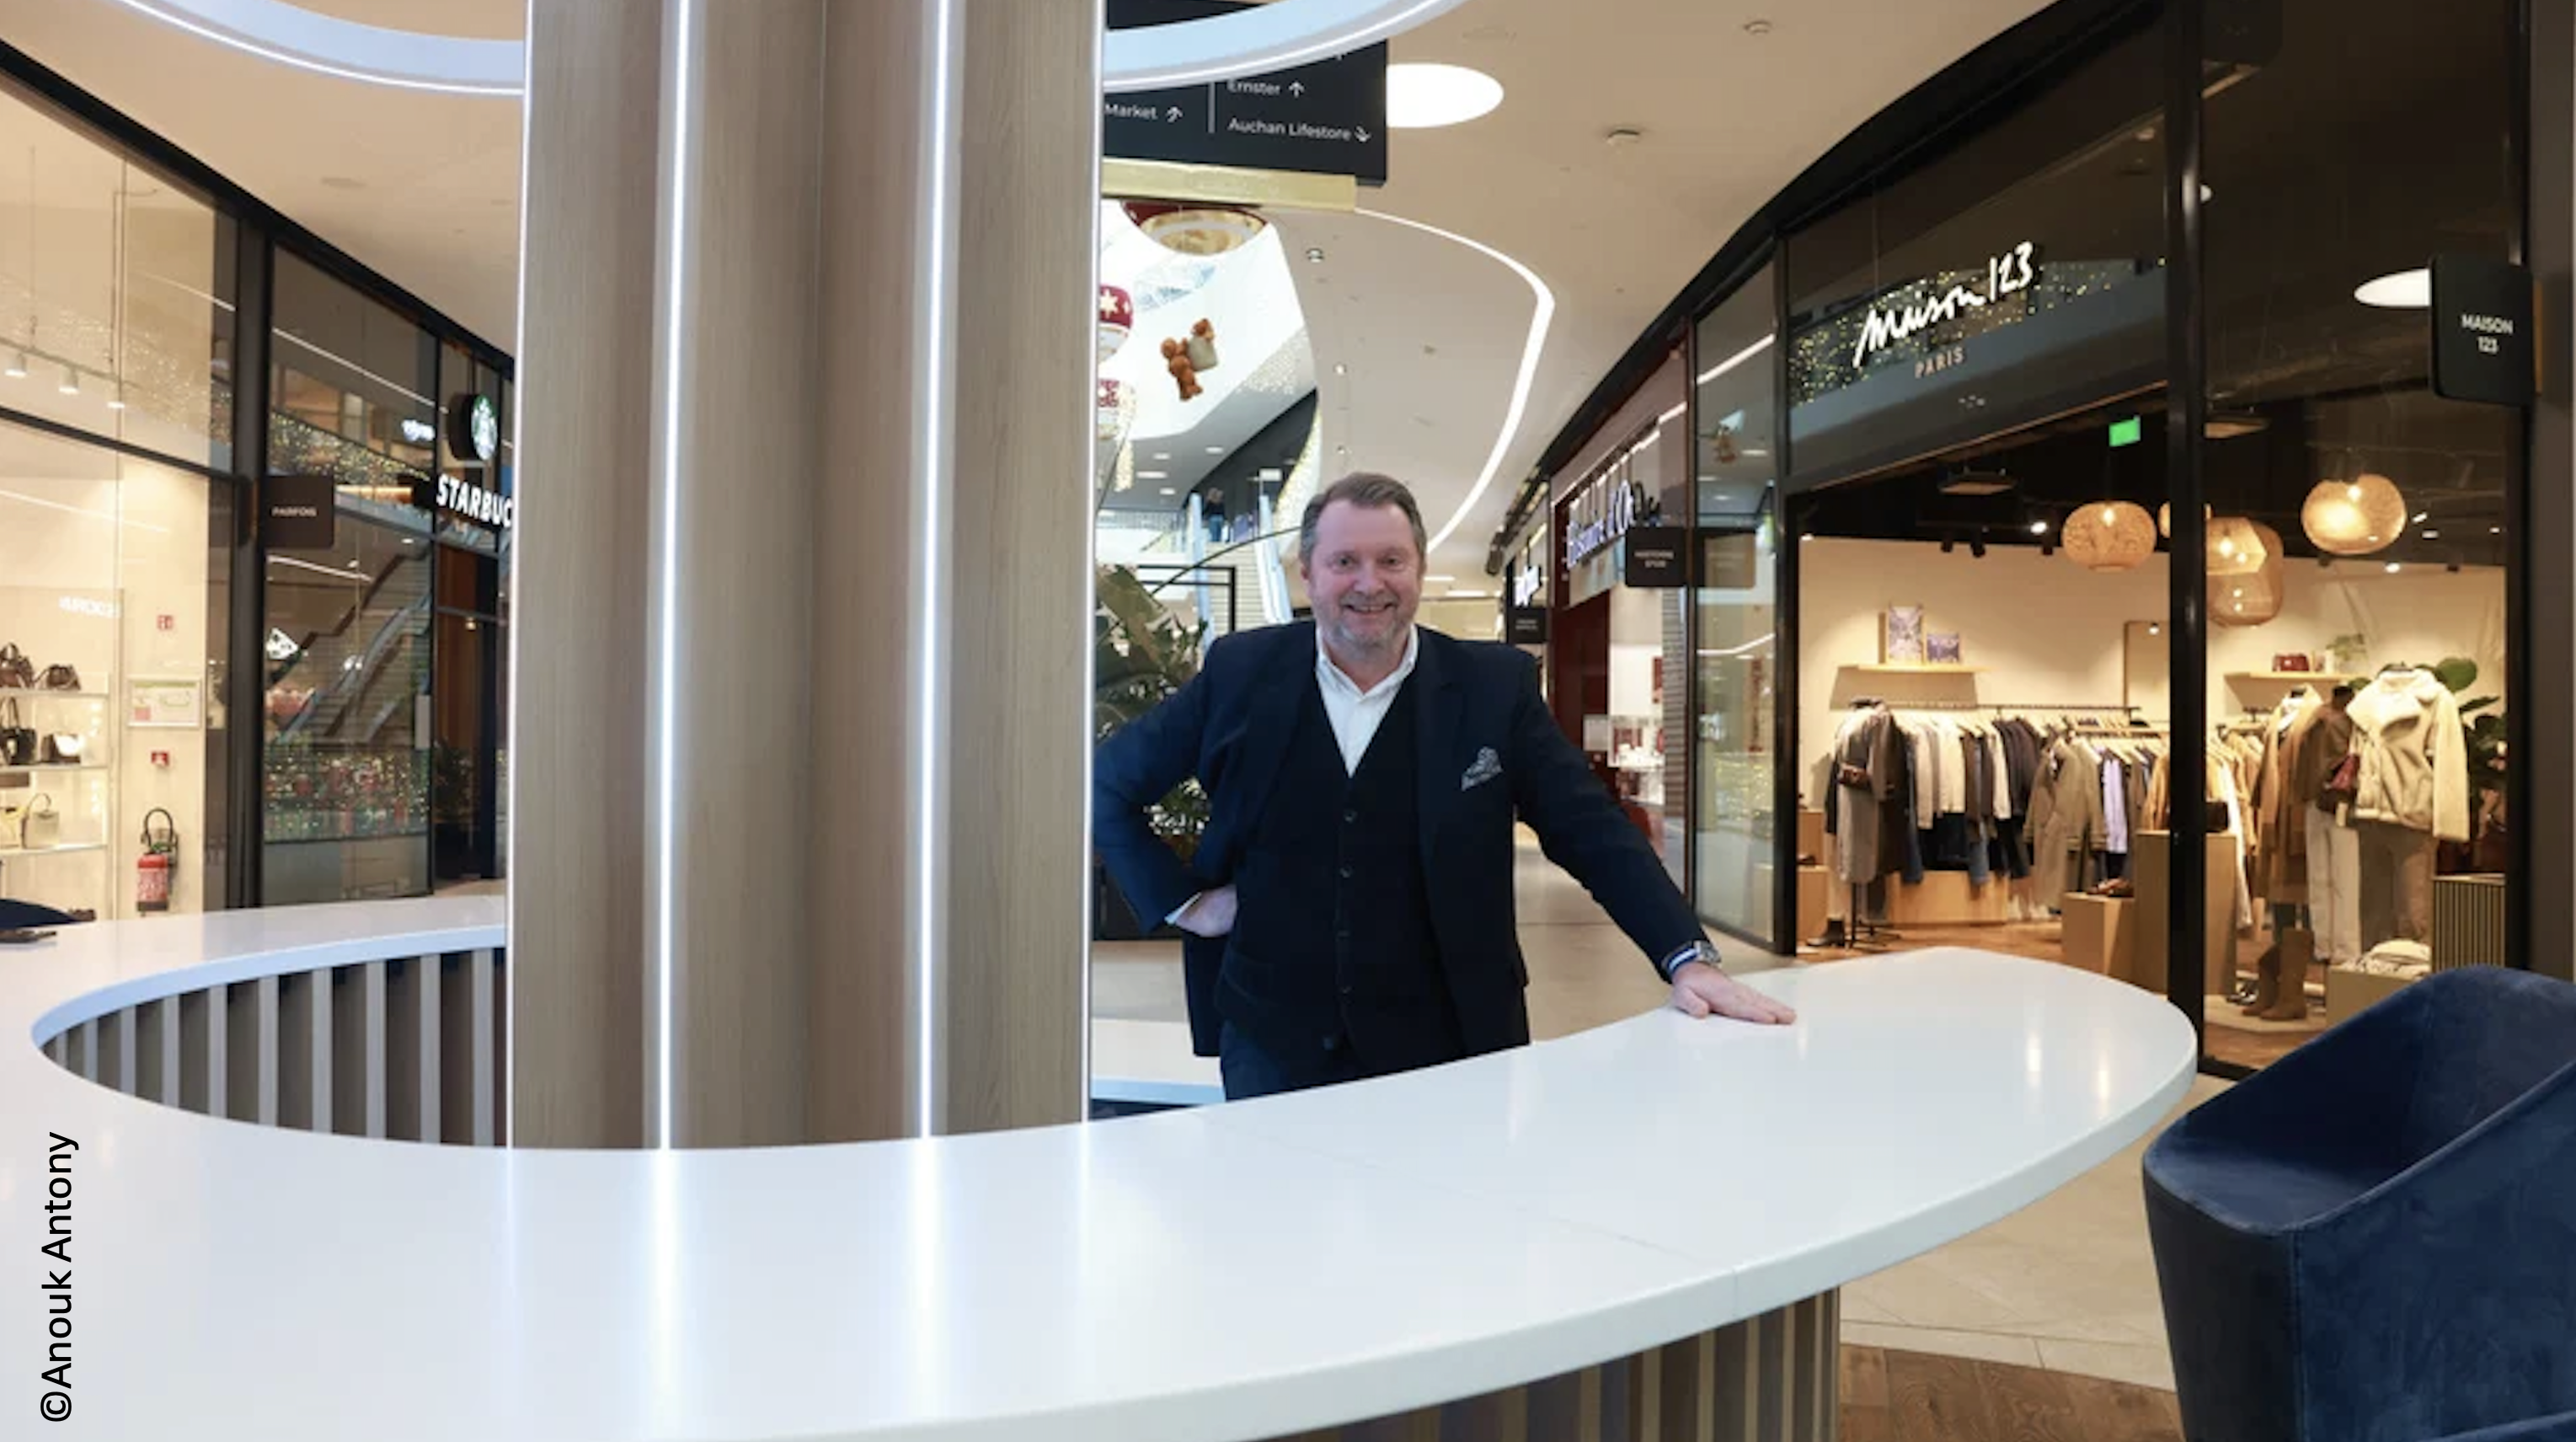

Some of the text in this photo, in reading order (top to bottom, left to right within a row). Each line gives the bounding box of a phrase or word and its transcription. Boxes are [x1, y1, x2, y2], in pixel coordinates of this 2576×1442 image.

[1104, 103, 1157, 120] Market
[1227, 117, 1351, 142] Auchan Lifestore
[1852, 241, 2034, 369] Maison 123
[2461, 313, 2514, 334] MAISON
[2477, 336, 2499, 354] 123
[1915, 345, 1964, 378] PARIS
